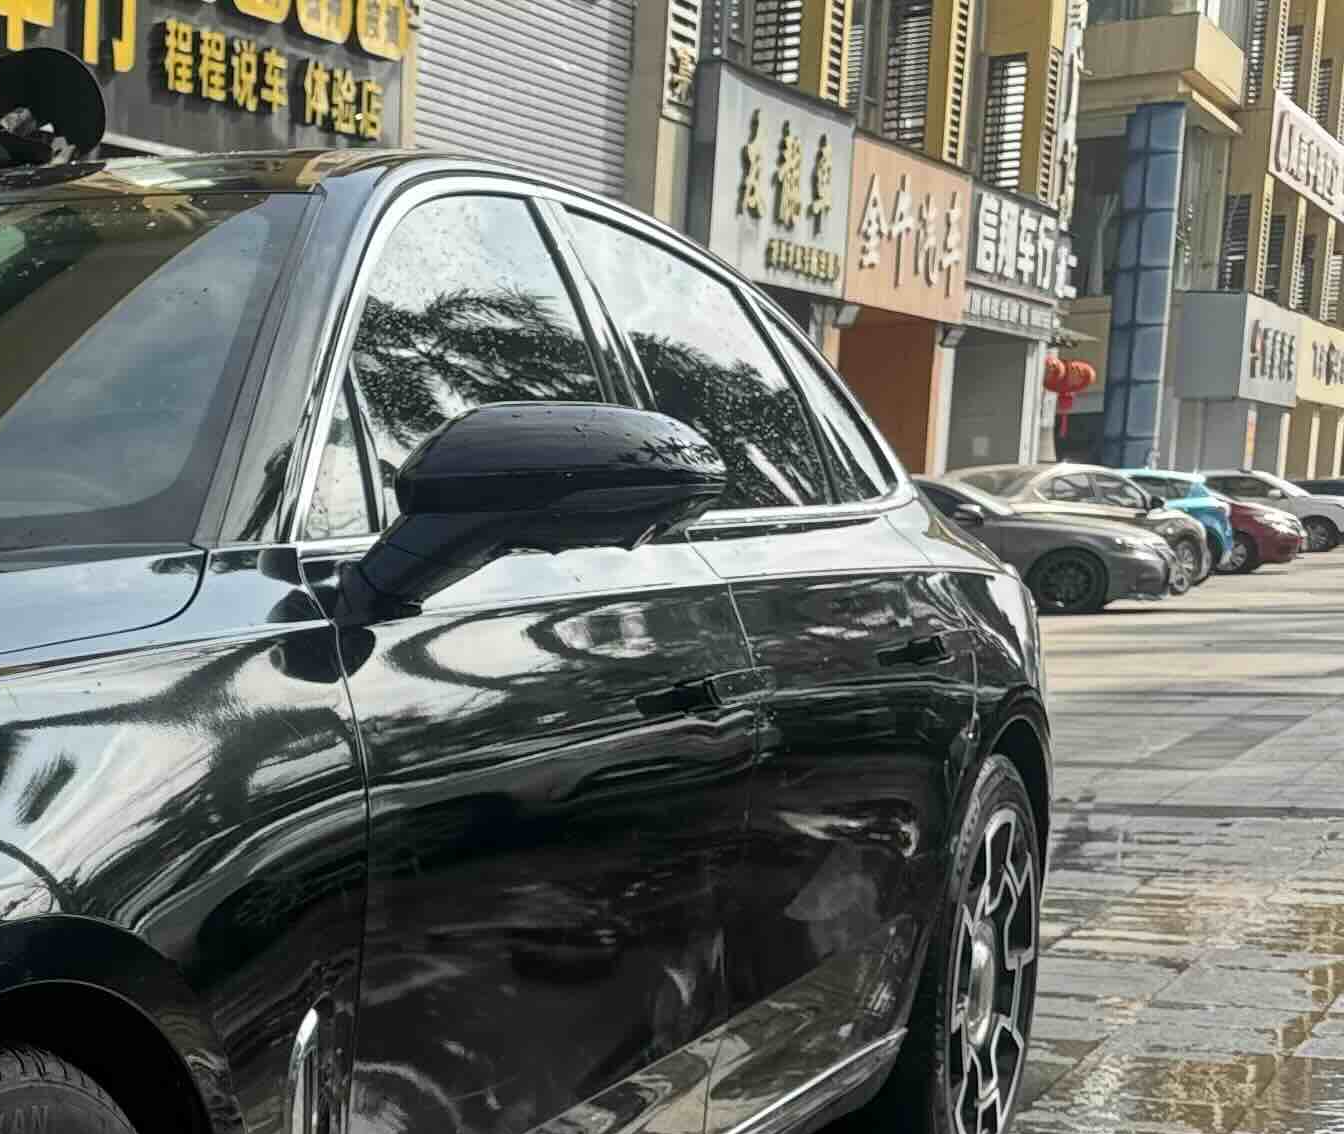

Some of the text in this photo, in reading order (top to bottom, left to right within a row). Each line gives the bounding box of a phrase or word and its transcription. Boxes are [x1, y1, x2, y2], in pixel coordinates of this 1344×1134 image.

[164, 18, 288, 113] 程程说车
[303, 60, 383, 141] 体验店
[857, 174, 962, 298] 金牛汽车
